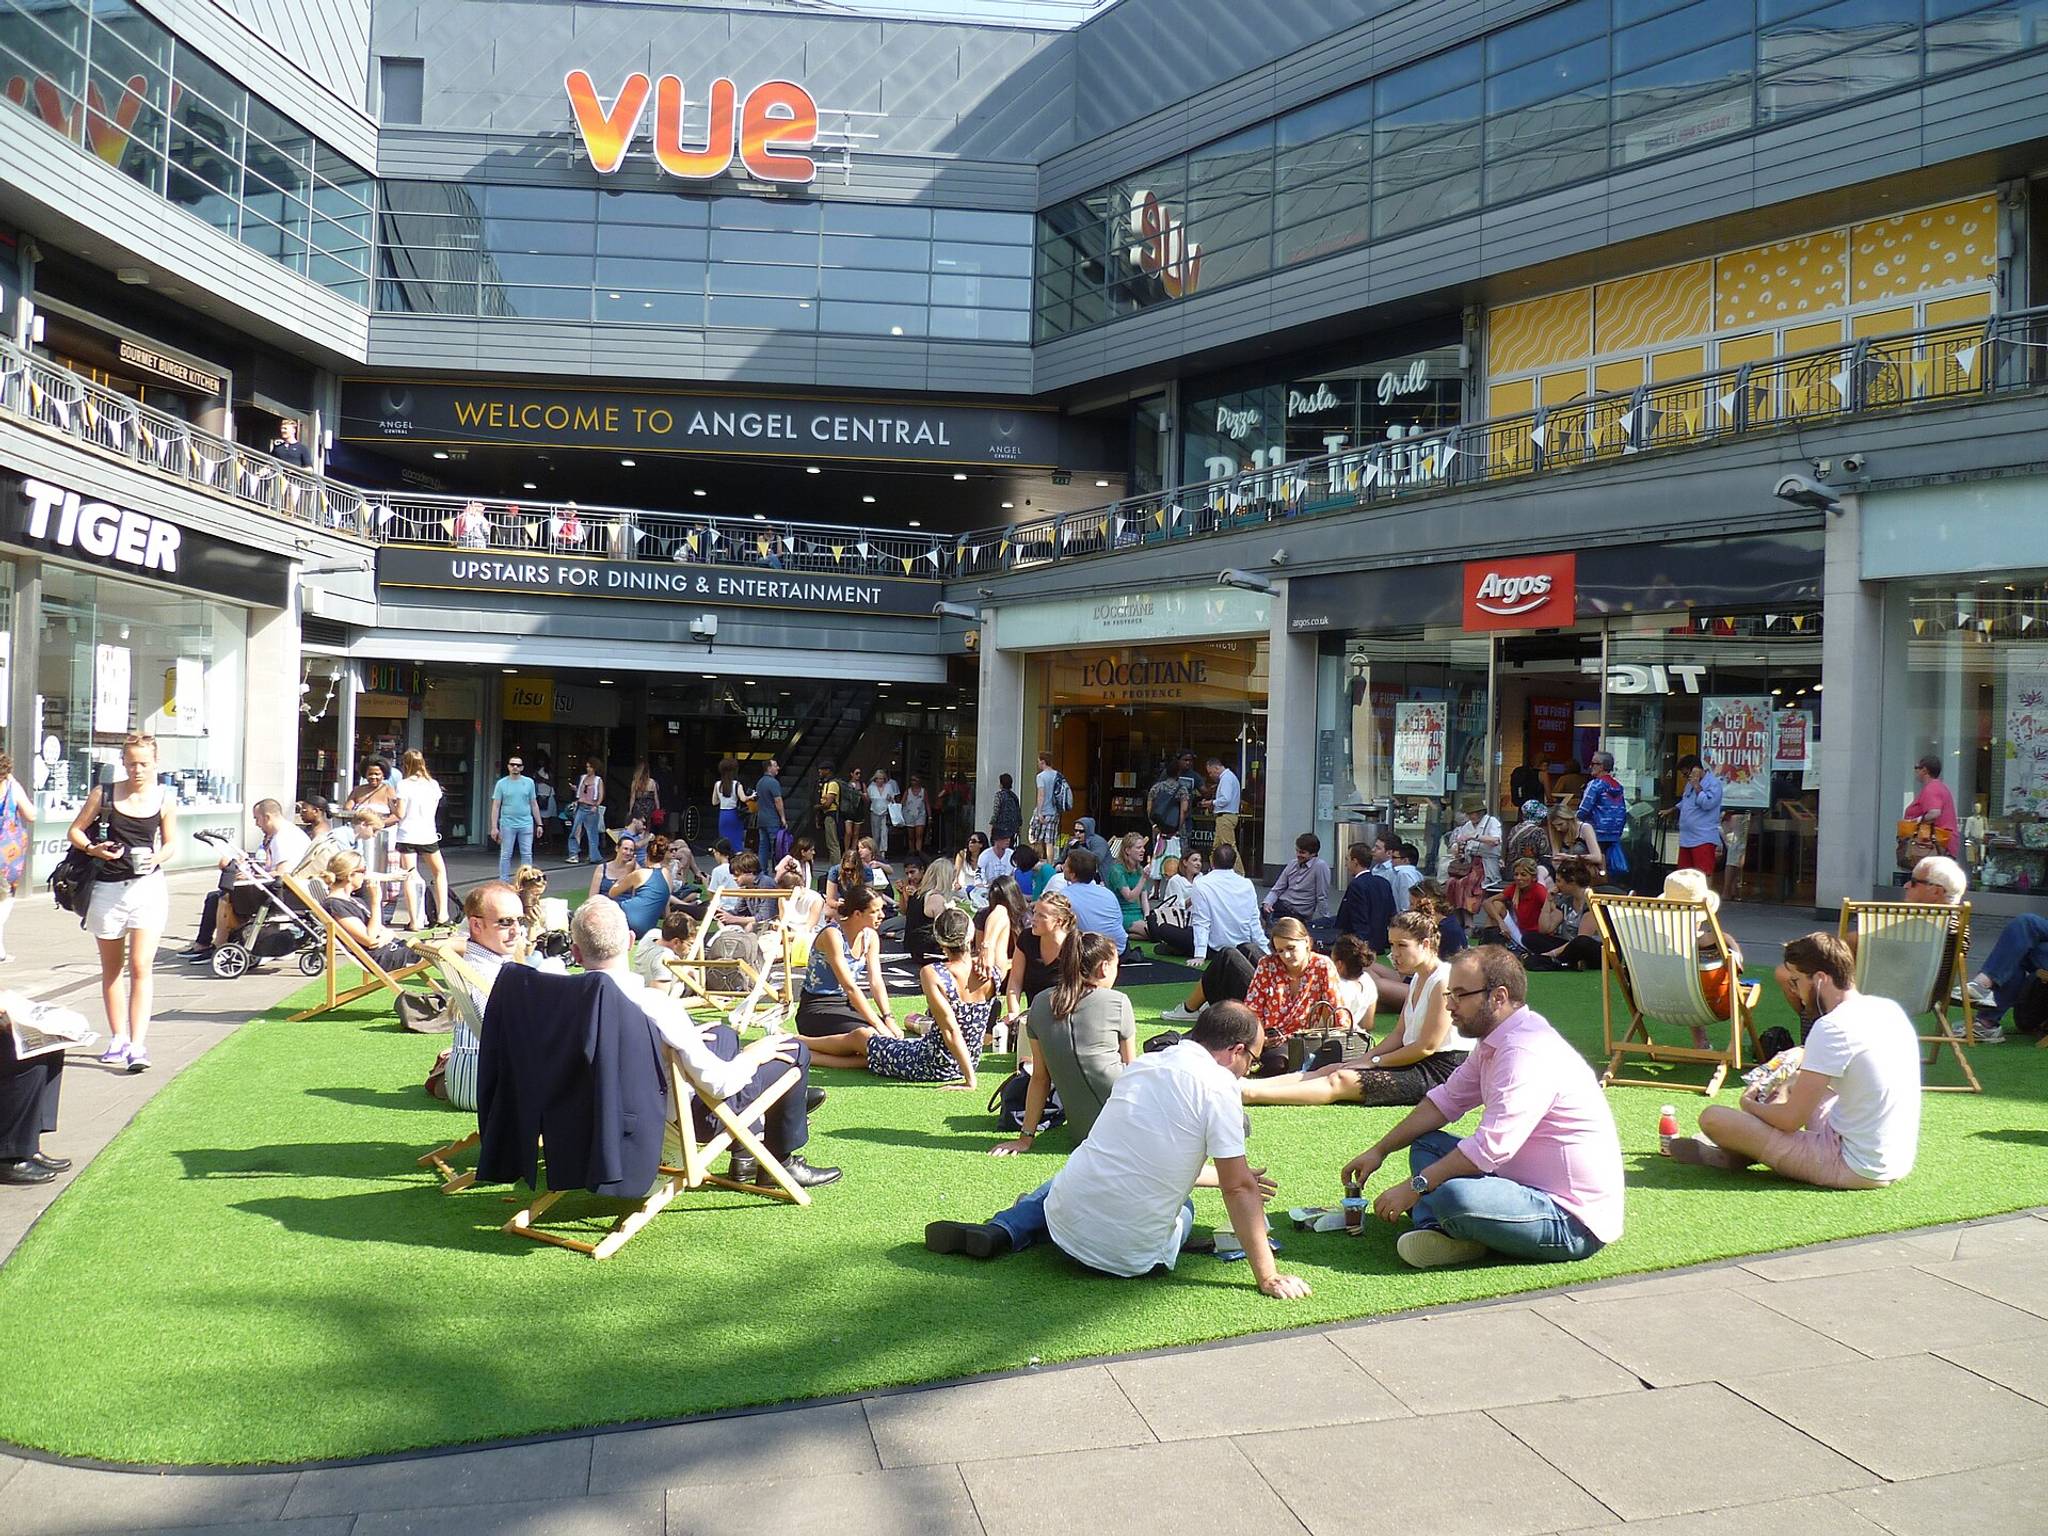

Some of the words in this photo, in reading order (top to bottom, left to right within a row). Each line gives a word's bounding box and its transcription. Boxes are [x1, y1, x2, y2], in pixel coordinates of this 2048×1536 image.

[120, 344, 158, 368] GOURMET
[158, 359, 188, 381] BURGER
[188, 370, 220, 392] KITCHEN
[1288, 382, 1338, 418] Pasta
[379, 421, 413, 429] ANGEL
[455, 401, 619, 432] WELCOME
[632, 408, 673, 434] TO
[687, 410, 798, 439] ANGEL
[810, 416, 951, 446] CENTRAL
[1216, 406, 1261, 440] Pizza
[989, 445, 1022, 455] ANGEL
[24, 478, 182, 573] TIGER
[452, 560, 550, 584] UPSTAIRS
[558, 567, 599, 587] FOR
[608, 570, 688, 591] DINING
[696, 576, 710, 593] &
[718, 577, 882, 604] ENTERTAINMENT
[1476, 573, 1552, 604] Argos
[512, 686, 545, 706] itsu
[1412, 715, 1429, 730] GET
[1725, 713, 1748, 729] GET
[1702, 730, 1742, 748] READY
[1745, 731, 1770, 748] FOR
[1710, 749, 1760, 767] AUTUMN
[32, 839, 69, 856] TIGE
